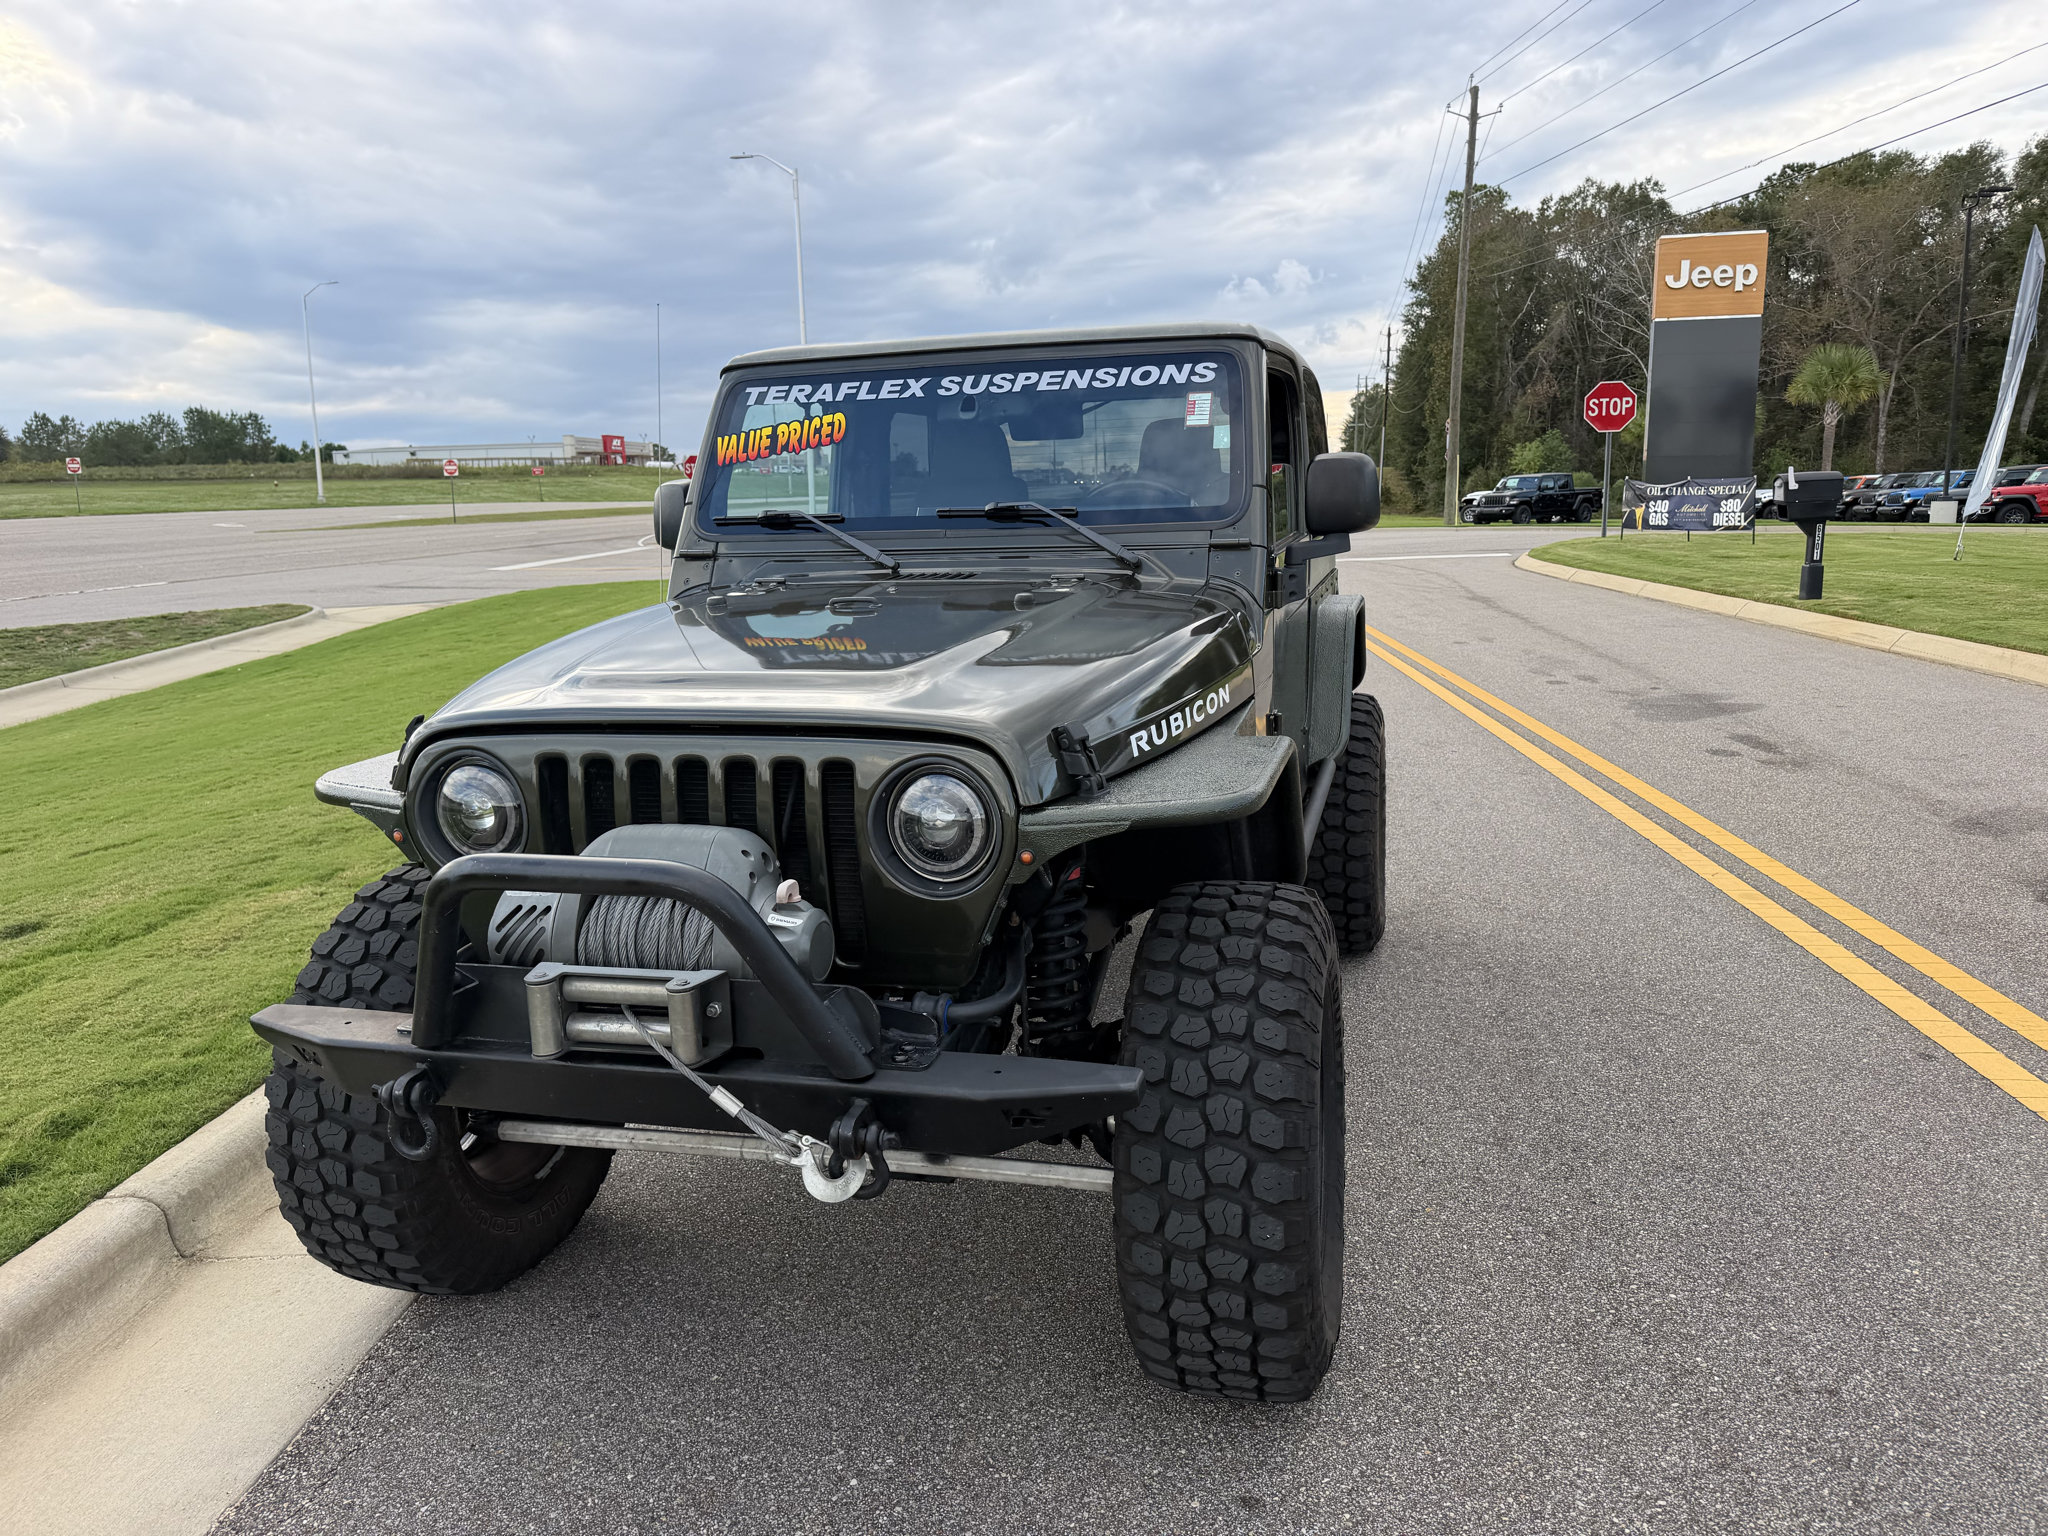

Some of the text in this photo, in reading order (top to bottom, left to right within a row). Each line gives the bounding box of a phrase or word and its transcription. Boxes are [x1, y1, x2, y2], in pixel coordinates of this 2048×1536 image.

[1665, 259, 1758, 292] Jeep
[744, 362, 1218, 405] TERAFLEX SUSPENSIONS
[1588, 397, 1633, 417] STOP
[717, 412, 846, 467] VALUE PRICED
[1647, 484, 1749, 496] OIL CHANGE SPECIAL
[1648, 499, 1669, 513] $40
[1720, 498, 1741, 513] $80
[1649, 513, 1669, 526] GAS
[1713, 512, 1747, 526] DIESEL
[1814, 524, 1823, 560] 6501
[1130, 683, 1230, 758] RUBICON
